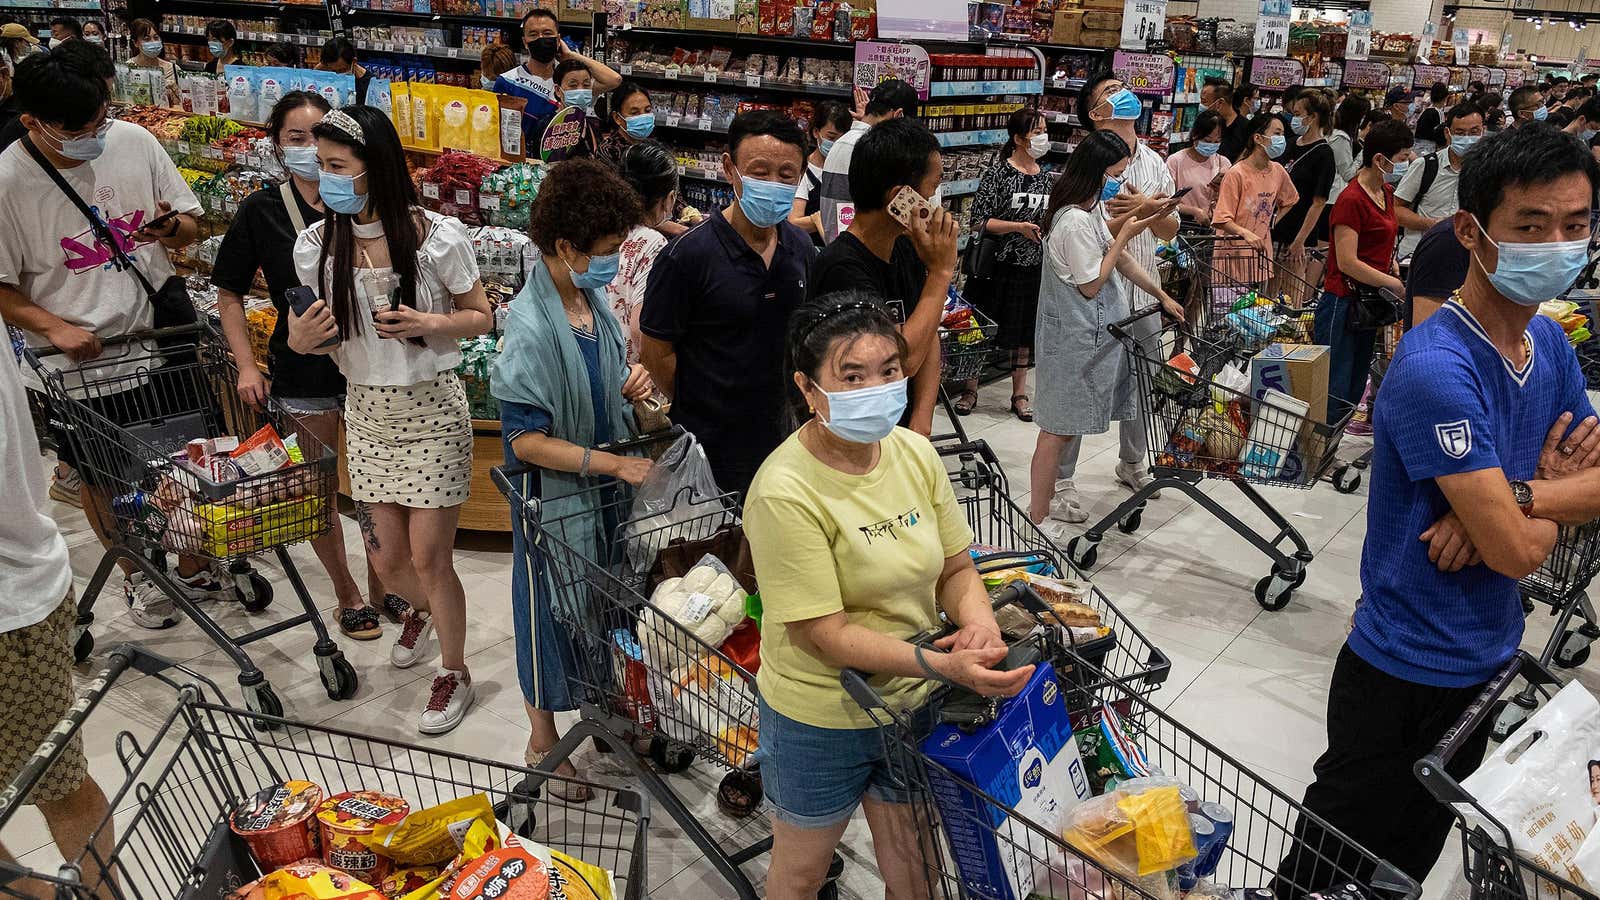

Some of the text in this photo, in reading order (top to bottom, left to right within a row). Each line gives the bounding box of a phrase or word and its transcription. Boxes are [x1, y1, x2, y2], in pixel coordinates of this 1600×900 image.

[530, 81, 551, 96] YONEX
[1132, 76, 1148, 88] 100
[1266, 78, 1280, 86] 100
[330, 853, 377, 870] 酸辣粉
